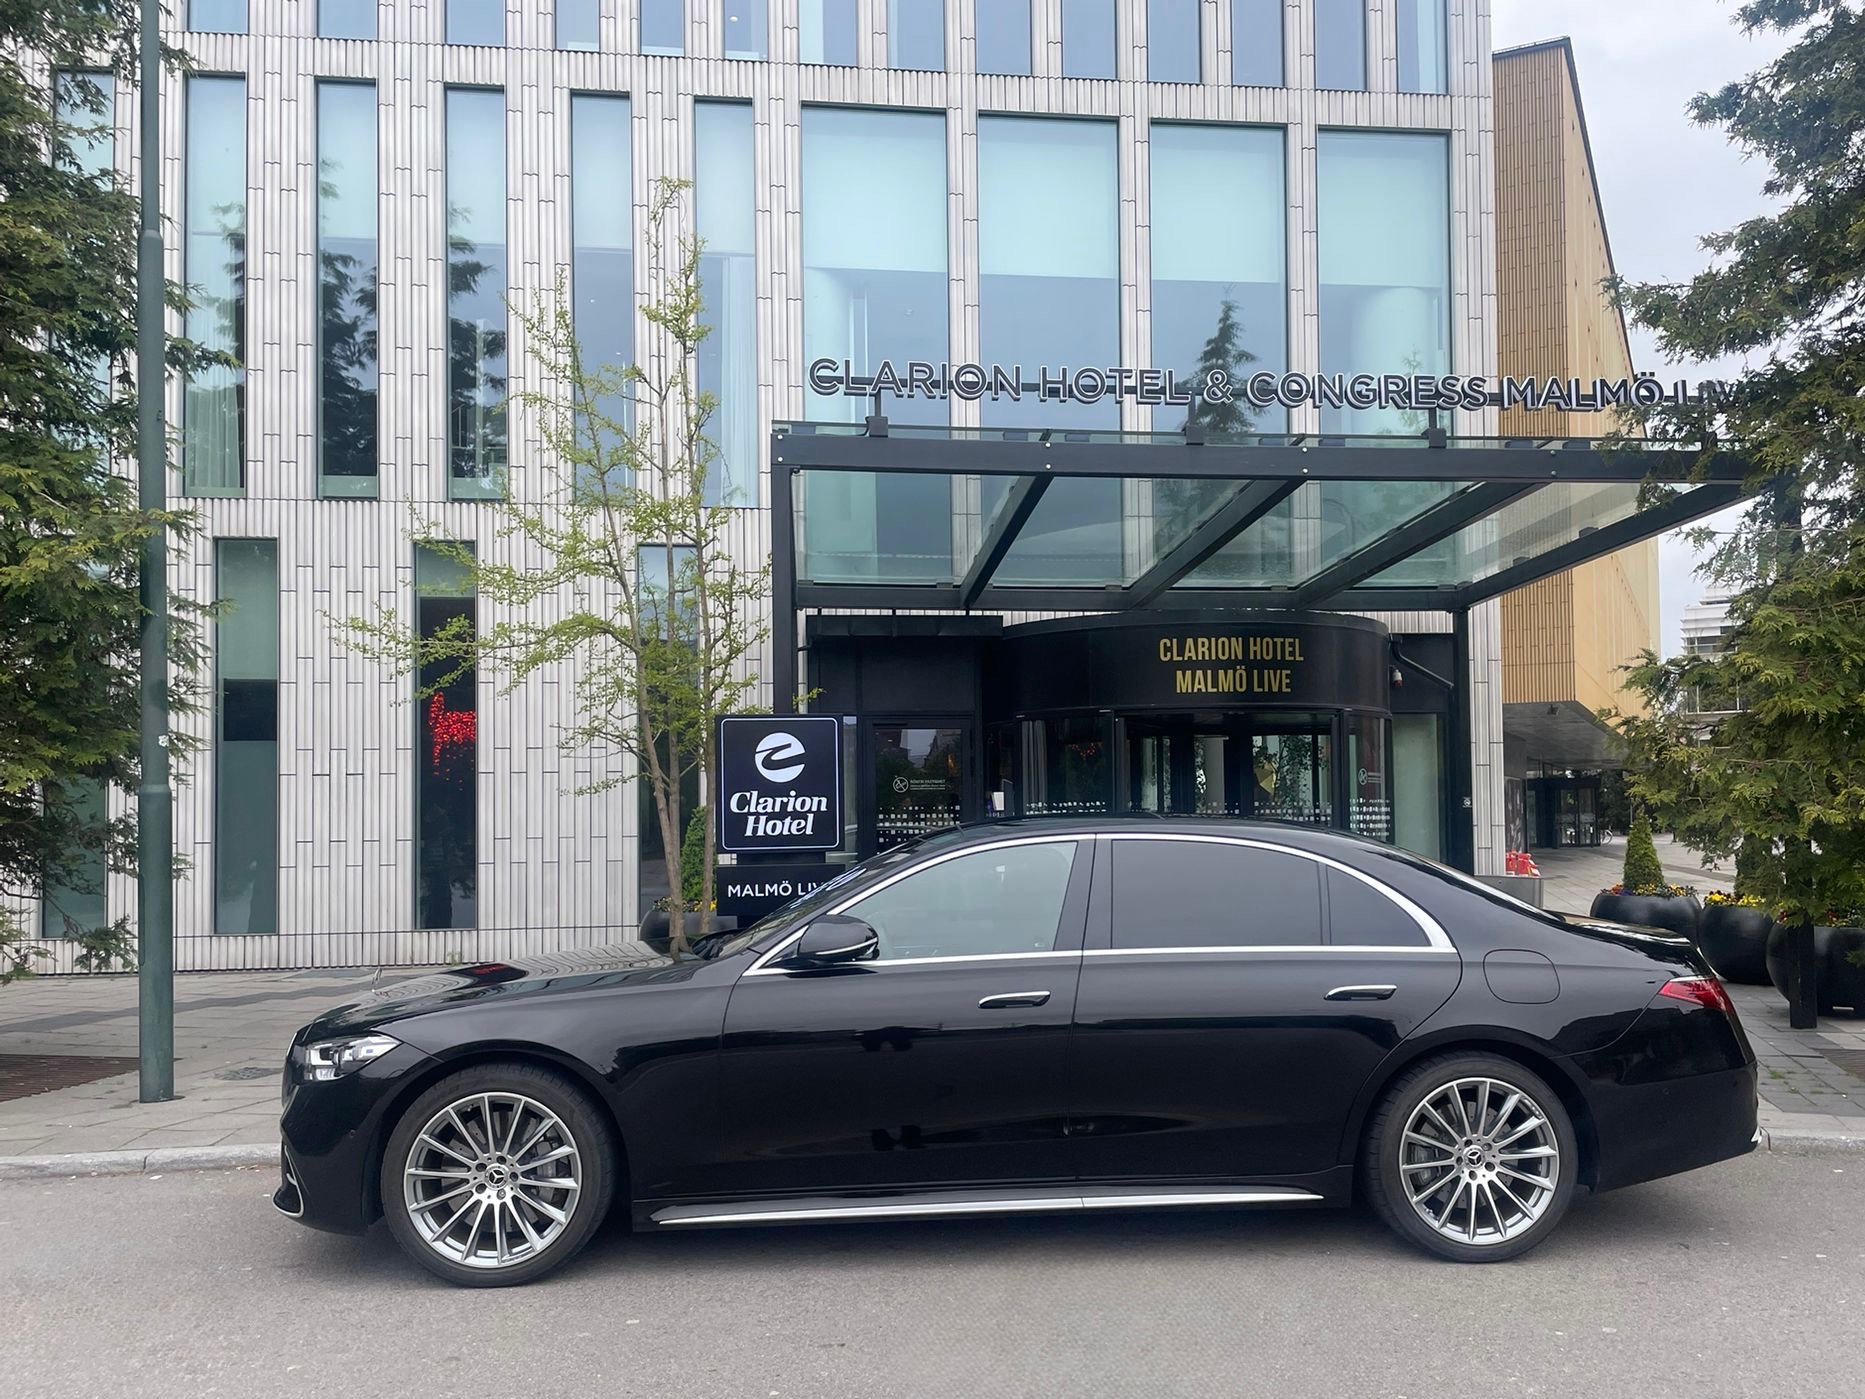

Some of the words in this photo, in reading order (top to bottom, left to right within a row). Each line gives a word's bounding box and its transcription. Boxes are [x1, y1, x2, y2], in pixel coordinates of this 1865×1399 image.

[808, 357, 1022, 402] CLARION
[1038, 364, 1192, 407] HOTEL
[1202, 368, 1234, 405] &
[1246, 370, 1491, 412] CONGRESS
[1499, 371, 1665, 413] MALMÖ
[1158, 637, 1244, 662] CLARION
[1248, 637, 1305, 662] HOTEL
[1175, 665, 1247, 694] MALMÖ
[1252, 669, 1292, 693] LIVE
[729, 790, 828, 814] Clarion
[744, 813, 814, 837] Hotel
[727, 880, 793, 897] MALMÖ
